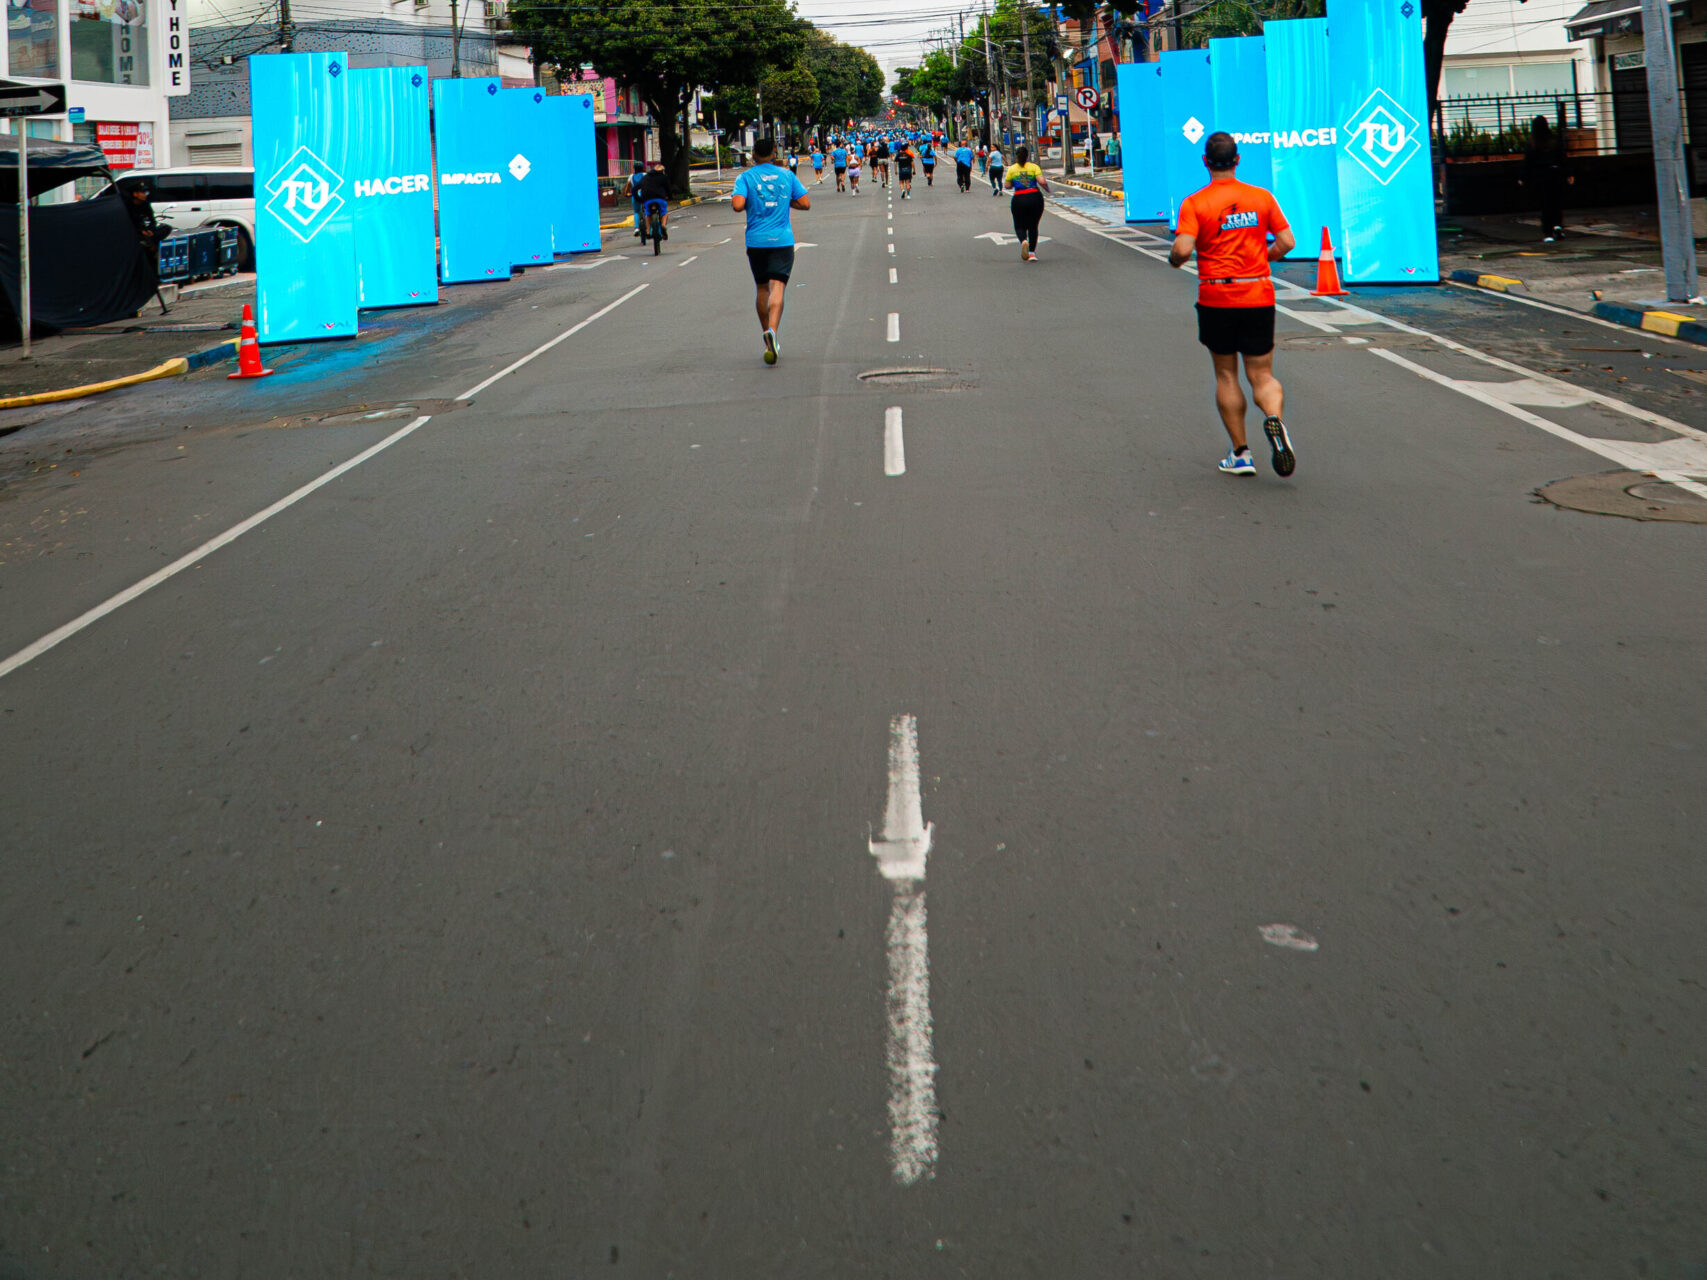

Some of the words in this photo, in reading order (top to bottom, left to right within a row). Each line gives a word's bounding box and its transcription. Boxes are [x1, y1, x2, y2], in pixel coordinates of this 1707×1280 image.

[168, 16, 183, 86] HOME
[1230, 132, 1271, 144] PACT
[1359, 122, 1405, 152] TU
[354, 174, 430, 198] HACER
[441, 172, 502, 185] IMPACTA
[281, 180, 330, 210] TU
[1225, 211, 1257, 225] TEAM
